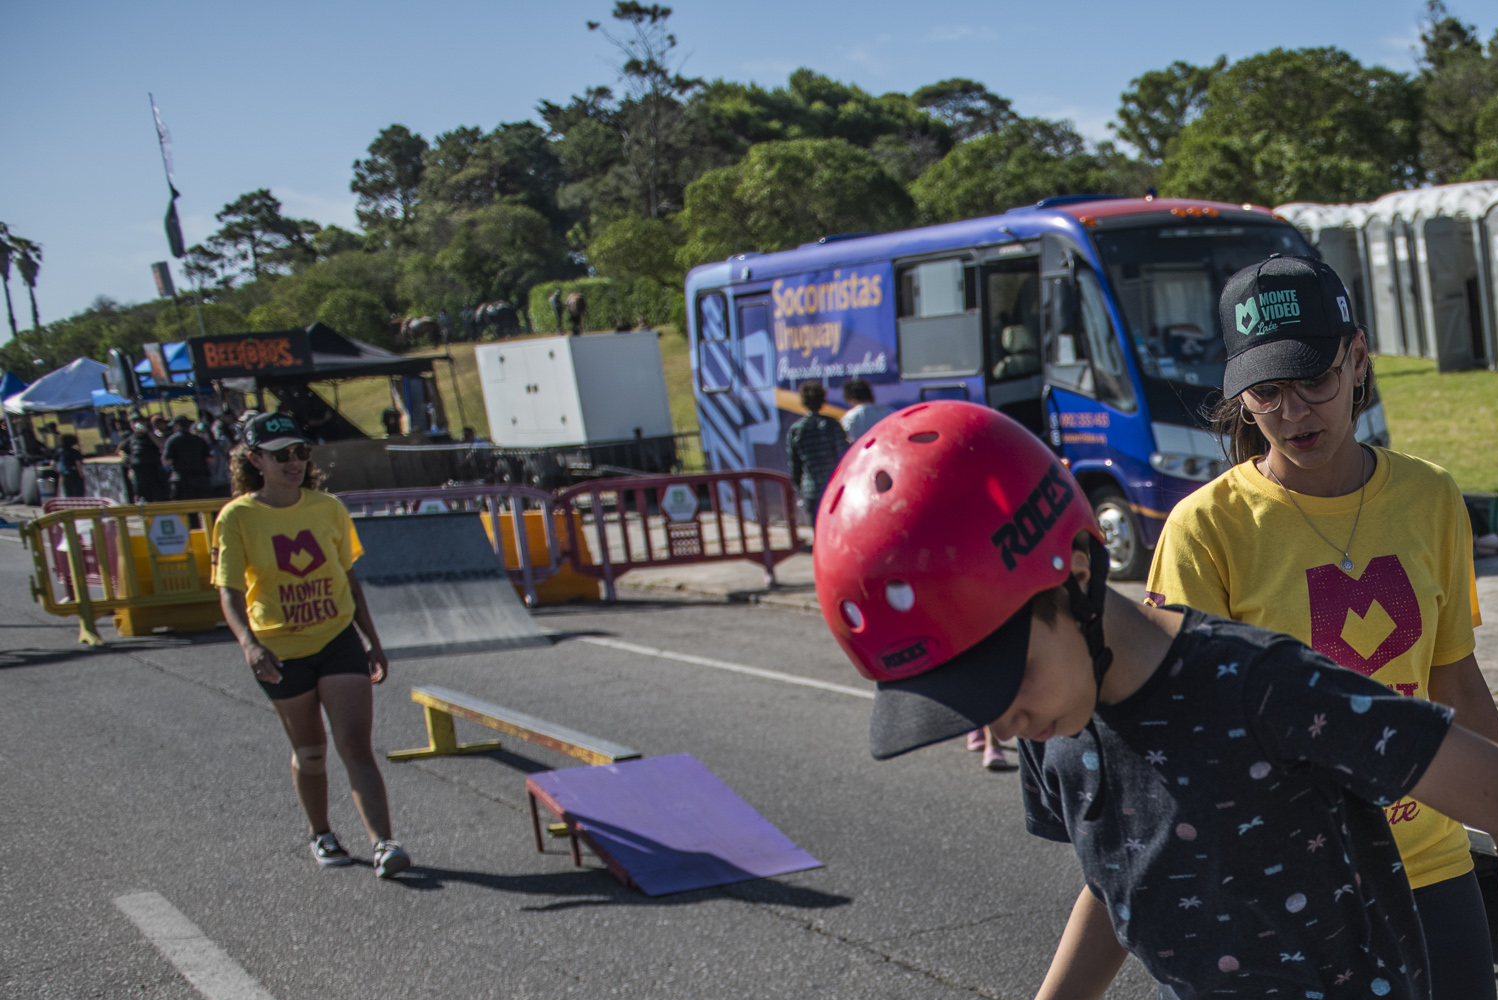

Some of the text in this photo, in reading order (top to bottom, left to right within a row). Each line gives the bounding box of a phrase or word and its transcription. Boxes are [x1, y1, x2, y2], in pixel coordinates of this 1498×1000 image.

[772, 269, 882, 319] Socorristas
[1259, 289, 1298, 307] MONTE
[1261, 302, 1300, 322] VIDEO
[774, 320, 842, 358] Uruguay
[1256, 321, 1279, 336] Late
[991, 462, 1075, 573] ROCES
[278, 577, 334, 604] MONTE
[281, 598, 339, 625] VIDEO
